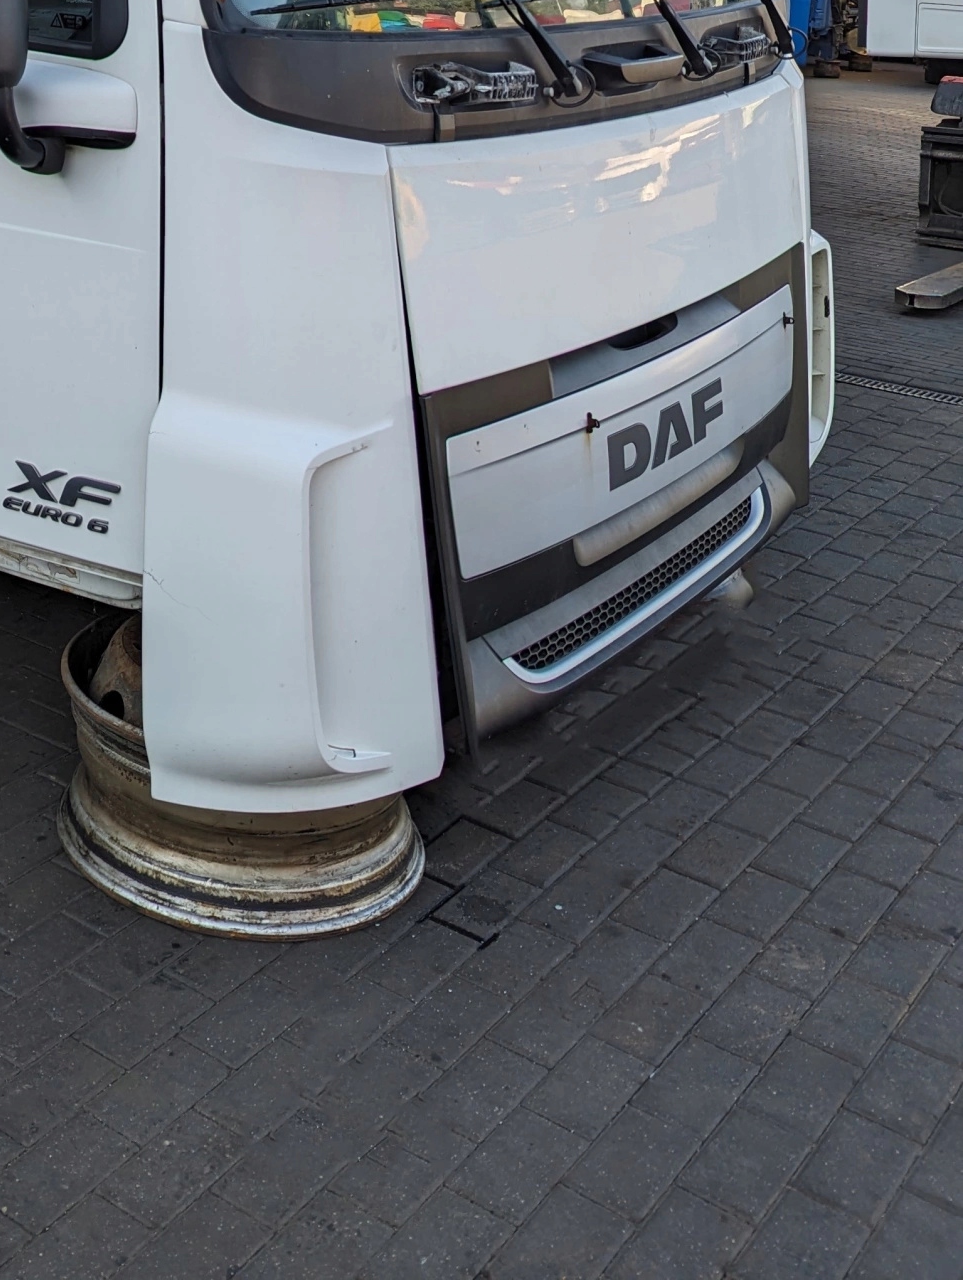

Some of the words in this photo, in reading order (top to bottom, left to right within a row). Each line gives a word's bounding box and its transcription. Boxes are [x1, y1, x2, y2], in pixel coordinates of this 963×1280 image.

[607, 377, 724, 491] DAF
[7, 459, 122, 507] XF
[2, 496, 83, 528] EURO
[87, 518, 110, 535] 6
